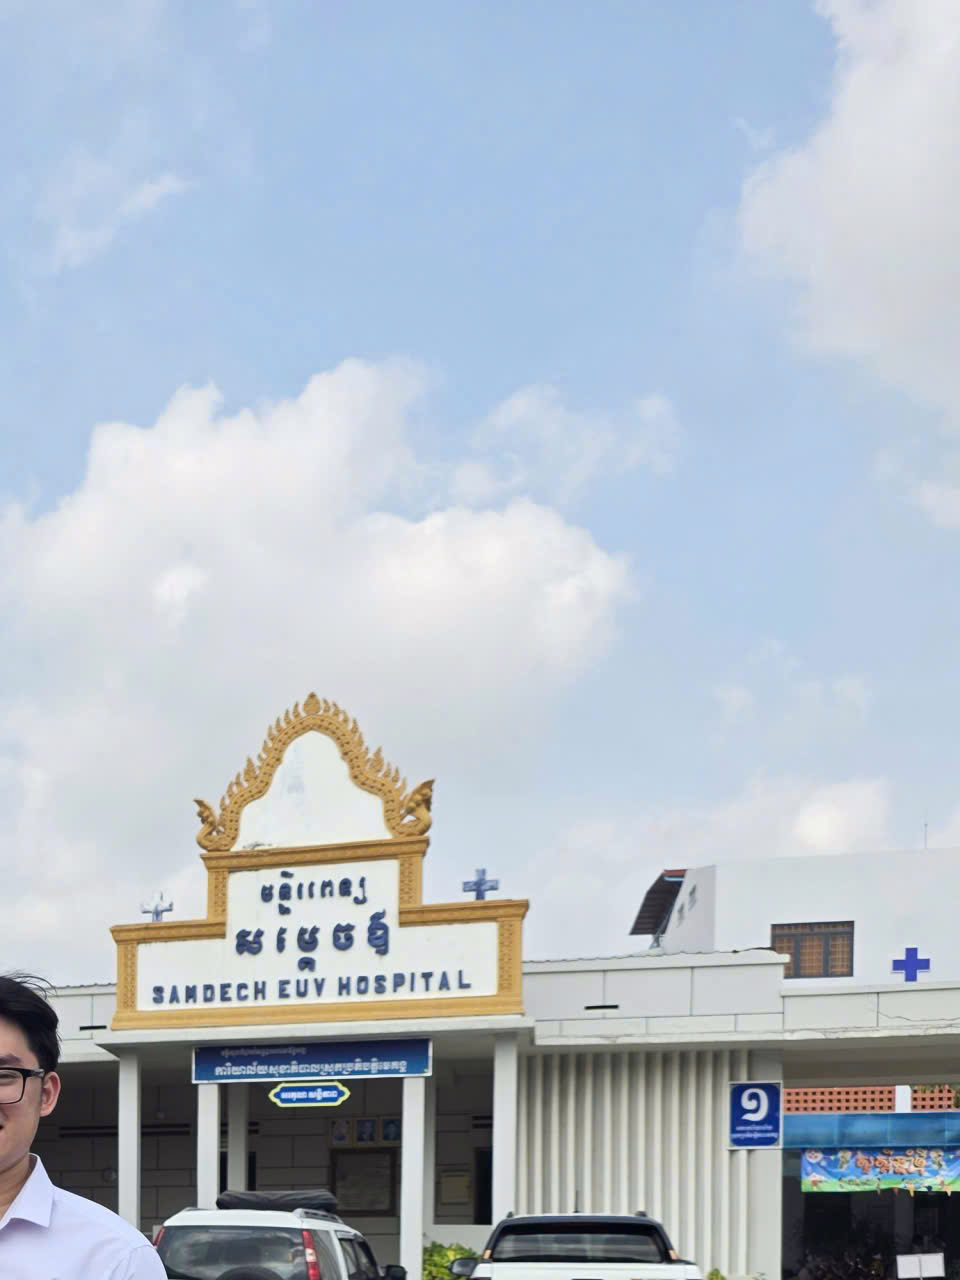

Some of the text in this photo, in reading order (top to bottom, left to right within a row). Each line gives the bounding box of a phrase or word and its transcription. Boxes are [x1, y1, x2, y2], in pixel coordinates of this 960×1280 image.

[152, 969, 472, 1004] SAMDECH EUV HOSPITAL
